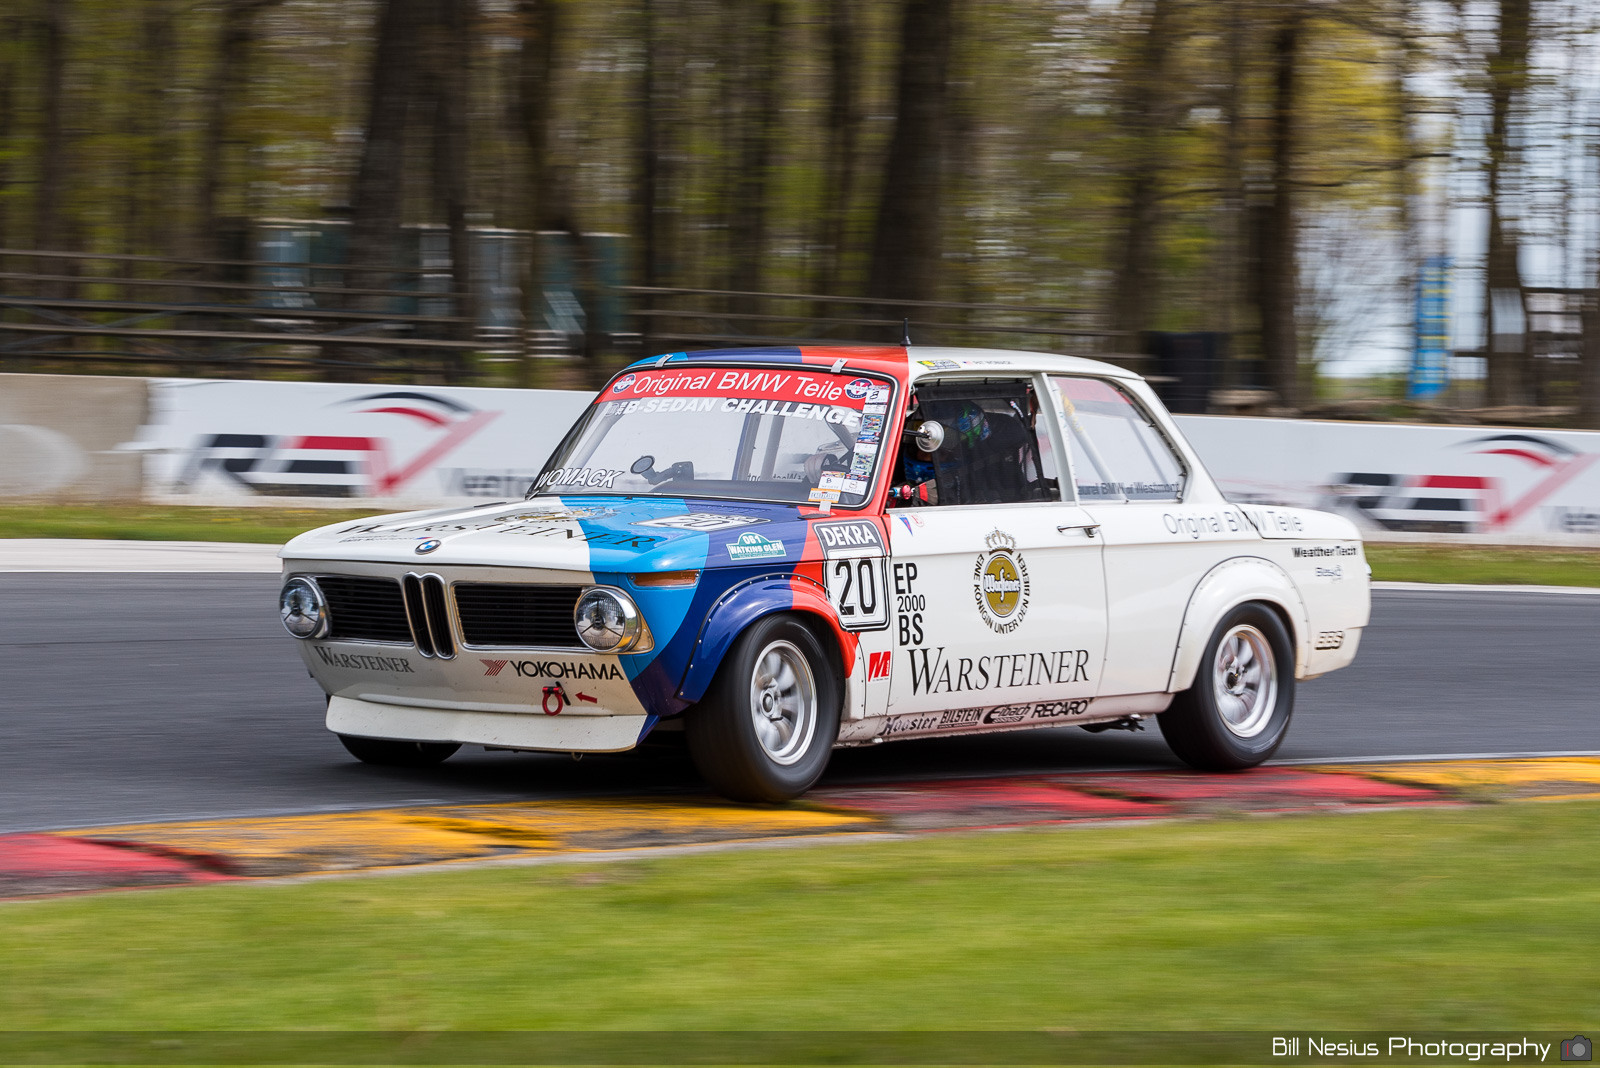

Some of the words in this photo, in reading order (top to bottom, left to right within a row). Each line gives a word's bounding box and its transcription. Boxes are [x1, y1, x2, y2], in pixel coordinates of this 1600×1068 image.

[633, 371, 716, 396] Original
[716, 371, 792, 393] BMW
[794, 375, 843, 401] Teile
[623, 398, 716, 415] B-SEDAN
[720, 398, 863, 428] CHALLENGE
[533, 467, 626, 489] WOMACK
[820, 524, 878, 547] DEKRA
[1163, 511, 1225, 540] Original
[1228, 511, 1267, 533] BMW
[1267, 511, 1304, 533] Teile
[729, 544, 764, 555] WATKINS
[763, 541, 783, 553] GLEN
[834, 558, 877, 617] 20
[894, 562, 918, 595] EP
[897, 595, 926, 612] 2000
[899, 614, 925, 646] BS
[313, 645, 415, 674] WARSTEINER
[510, 659, 625, 681] YOKOHAMA
[906, 646, 1091, 697] WARSTEINER
[939, 707, 985, 725] BILSTEIN
[1031, 699, 1089, 719] RECARO
[877, 712, 938, 736] Hoosier
